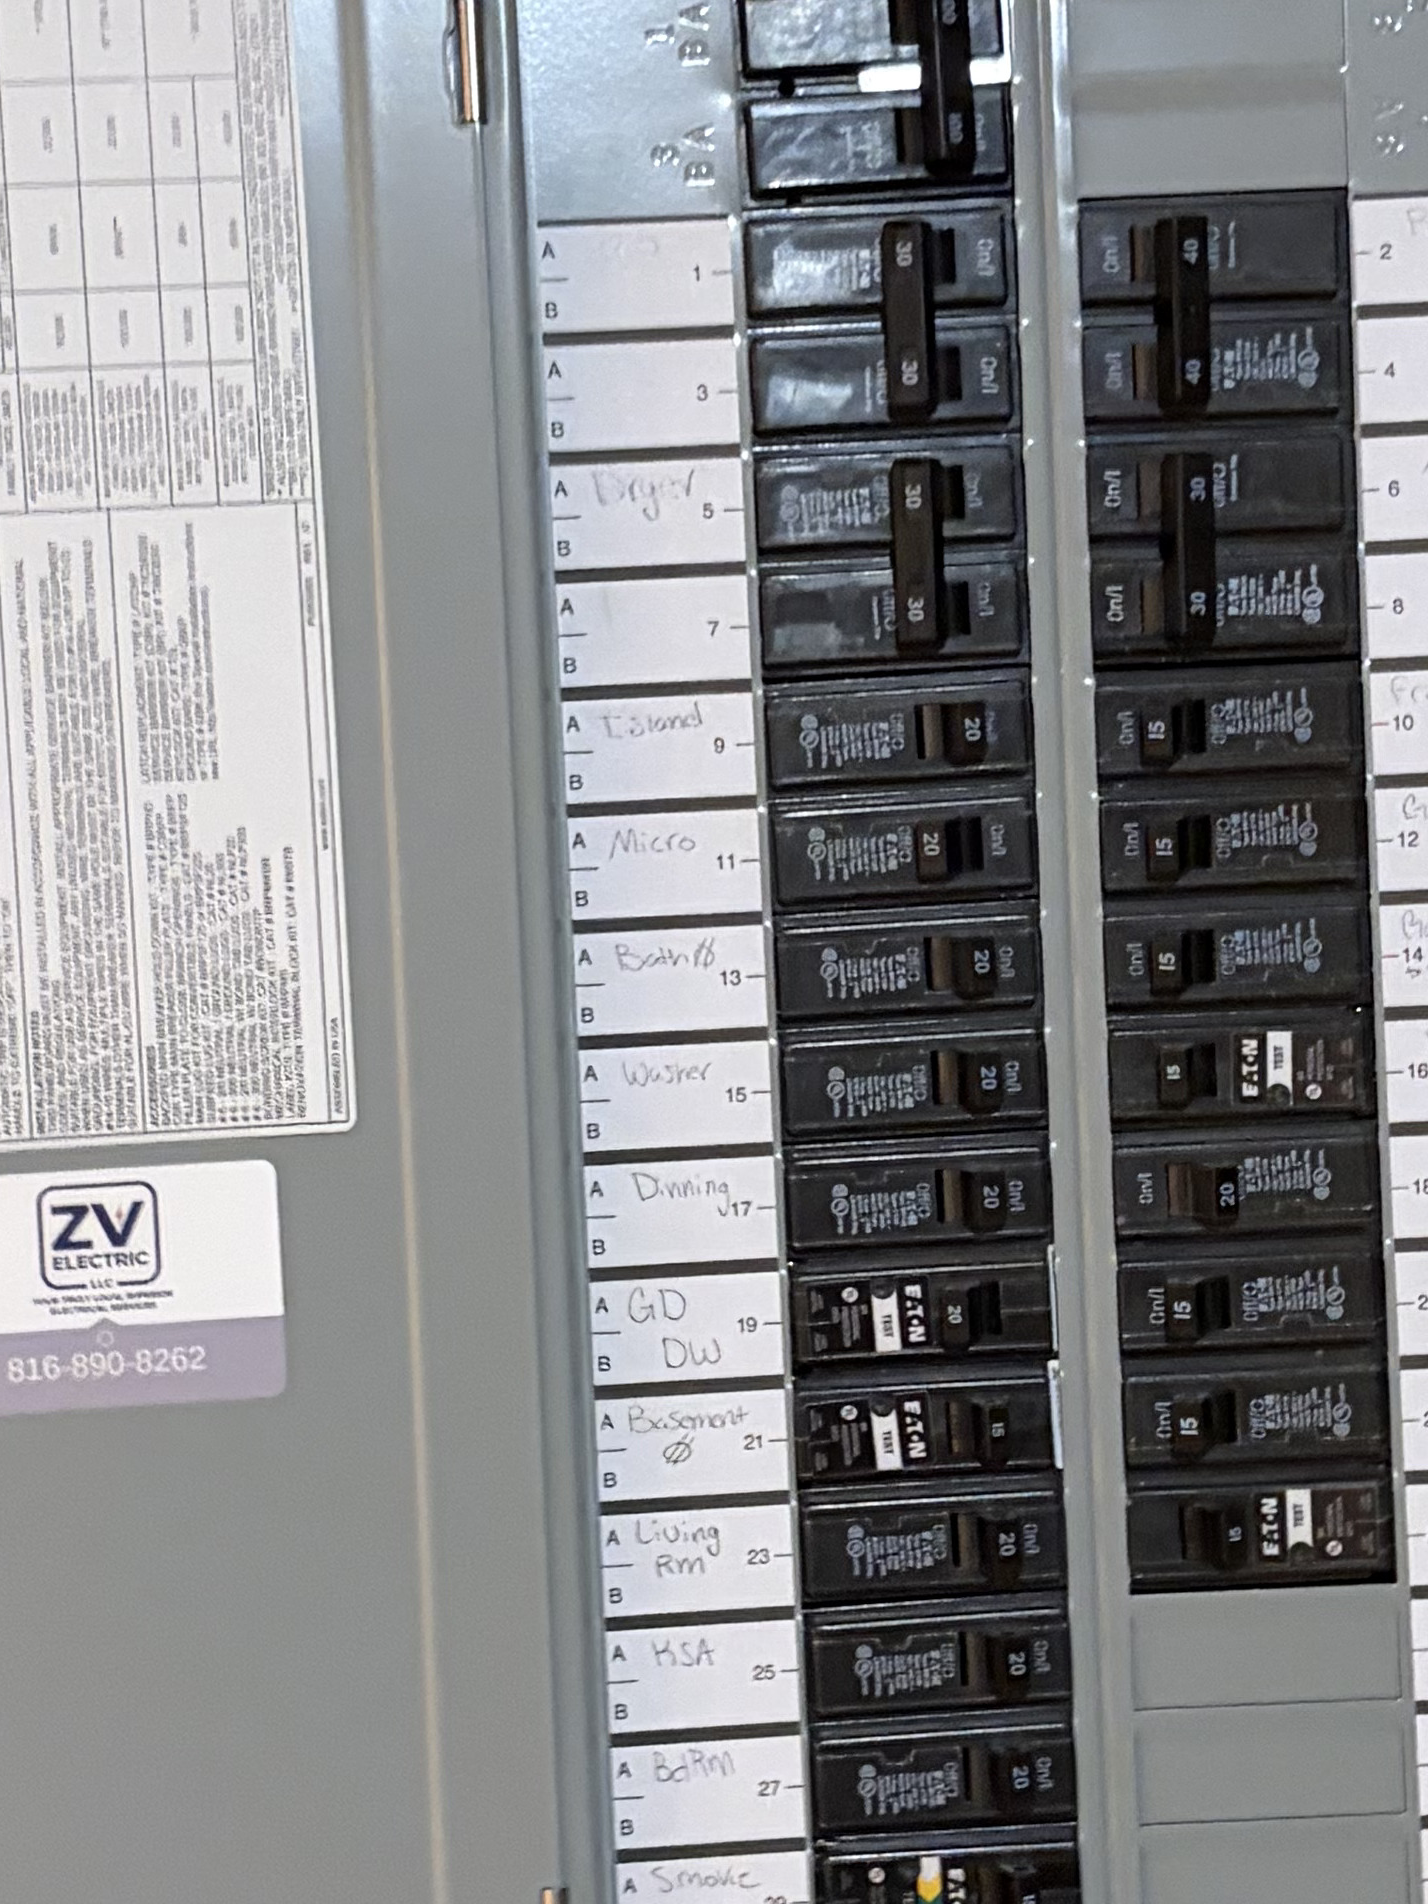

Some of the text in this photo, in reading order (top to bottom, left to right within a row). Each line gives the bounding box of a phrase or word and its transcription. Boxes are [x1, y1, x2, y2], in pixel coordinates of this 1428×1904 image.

[541, 241, 555, 259] A
[895, 240, 912, 268] 30
[1183, 238, 1199, 265] 40
[1379, 244, 1392, 260] 2
[693, 265, 700, 281] 1
[545, 302, 558, 319] B
[548, 361, 562, 379] A
[901, 358, 919, 386] 30
[1184, 358, 1200, 385] 40
[1384, 362, 1395, 377] 4
[696, 384, 708, 401] 3
[551, 421, 565, 439] B
[554, 480, 568, 497] A
[905, 483, 922, 510] 30
[1189, 476, 1206, 502] 30
[1388, 480, 1399, 496] 6
[702, 502, 714, 520] 5
[556, 540, 571, 557] B
[560, 598, 574, 615] A
[908, 596, 925, 622] 30
[1189, 590, 1206, 617] 30
[1392, 598, 1404, 615] 8
[707, 620, 719, 636] 7
[563, 657, 577, 674] B
[566, 715, 580, 732] A
[964, 716, 981, 742] 20
[1148, 719, 1165, 741] 15
[1394, 714, 1414, 731] 10
[713, 737, 725, 754] 9
[569, 774, 583, 791] B
[572, 832, 586, 849] A
[609, 829, 696, 860] Micro
[924, 832, 940, 857] 20
[1156, 837, 1173, 857] 15
[1398, 831, 1419, 847] 12
[716, 854, 734, 870] 11
[574, 890, 589, 908] B
[578, 948, 593, 966] A
[974, 949, 991, 975] 20
[1159, 952, 1176, 972] 15
[1403, 946, 1423, 963] 14
[720, 969, 742, 986] 13
[580, 1007, 595, 1024] B
[1273, 1043, 1285, 1070] TEST
[584, 1065, 599, 1082] A
[981, 1065, 997, 1092] 20
[1167, 1064, 1180, 1081] 15
[1408, 1063, 1428, 1079] 16
[725, 1086, 747, 1103] 15
[586, 1122, 601, 1140] B
[983, 1185, 1000, 1210] 20
[1220, 1182, 1236, 1207] 20
[731, 1201, 752, 1217] 17
[51, 1200, 145, 1252] ZV
[51, 1250, 150, 1272] ELECTRIC
[89, 1278, 114, 1290] LLC
[628, 1287, 686, 1324] GD
[1174, 1300, 1192, 1320] 15
[737, 1316, 759, 1333] 19
[947, 1305, 963, 1326] 20
[881, 1314, 894, 1338] TEST
[662, 1337, 722, 1369] DW
[6, 1345, 209, 1384] 816-890-8262
[628, 1405, 748, 1434] Basement
[1180, 1417, 1198, 1436] 15
[992, 1422, 1005, 1439] 15
[743, 1434, 763, 1450] 21
[882, 1430, 894, 1456] TEST
[1293, 1503, 1305, 1527] TEST
[635, 1520, 720, 1556] Living
[1229, 1526, 1242, 1542] 15
[1000, 1532, 1017, 1557] 20
[747, 1548, 771, 1565] 23
[752, 1665, 776, 1681] 25
[1009, 1652, 1026, 1677] 20
[1014, 1765, 1030, 1790] 20
[758, 1779, 781, 1796] 27
